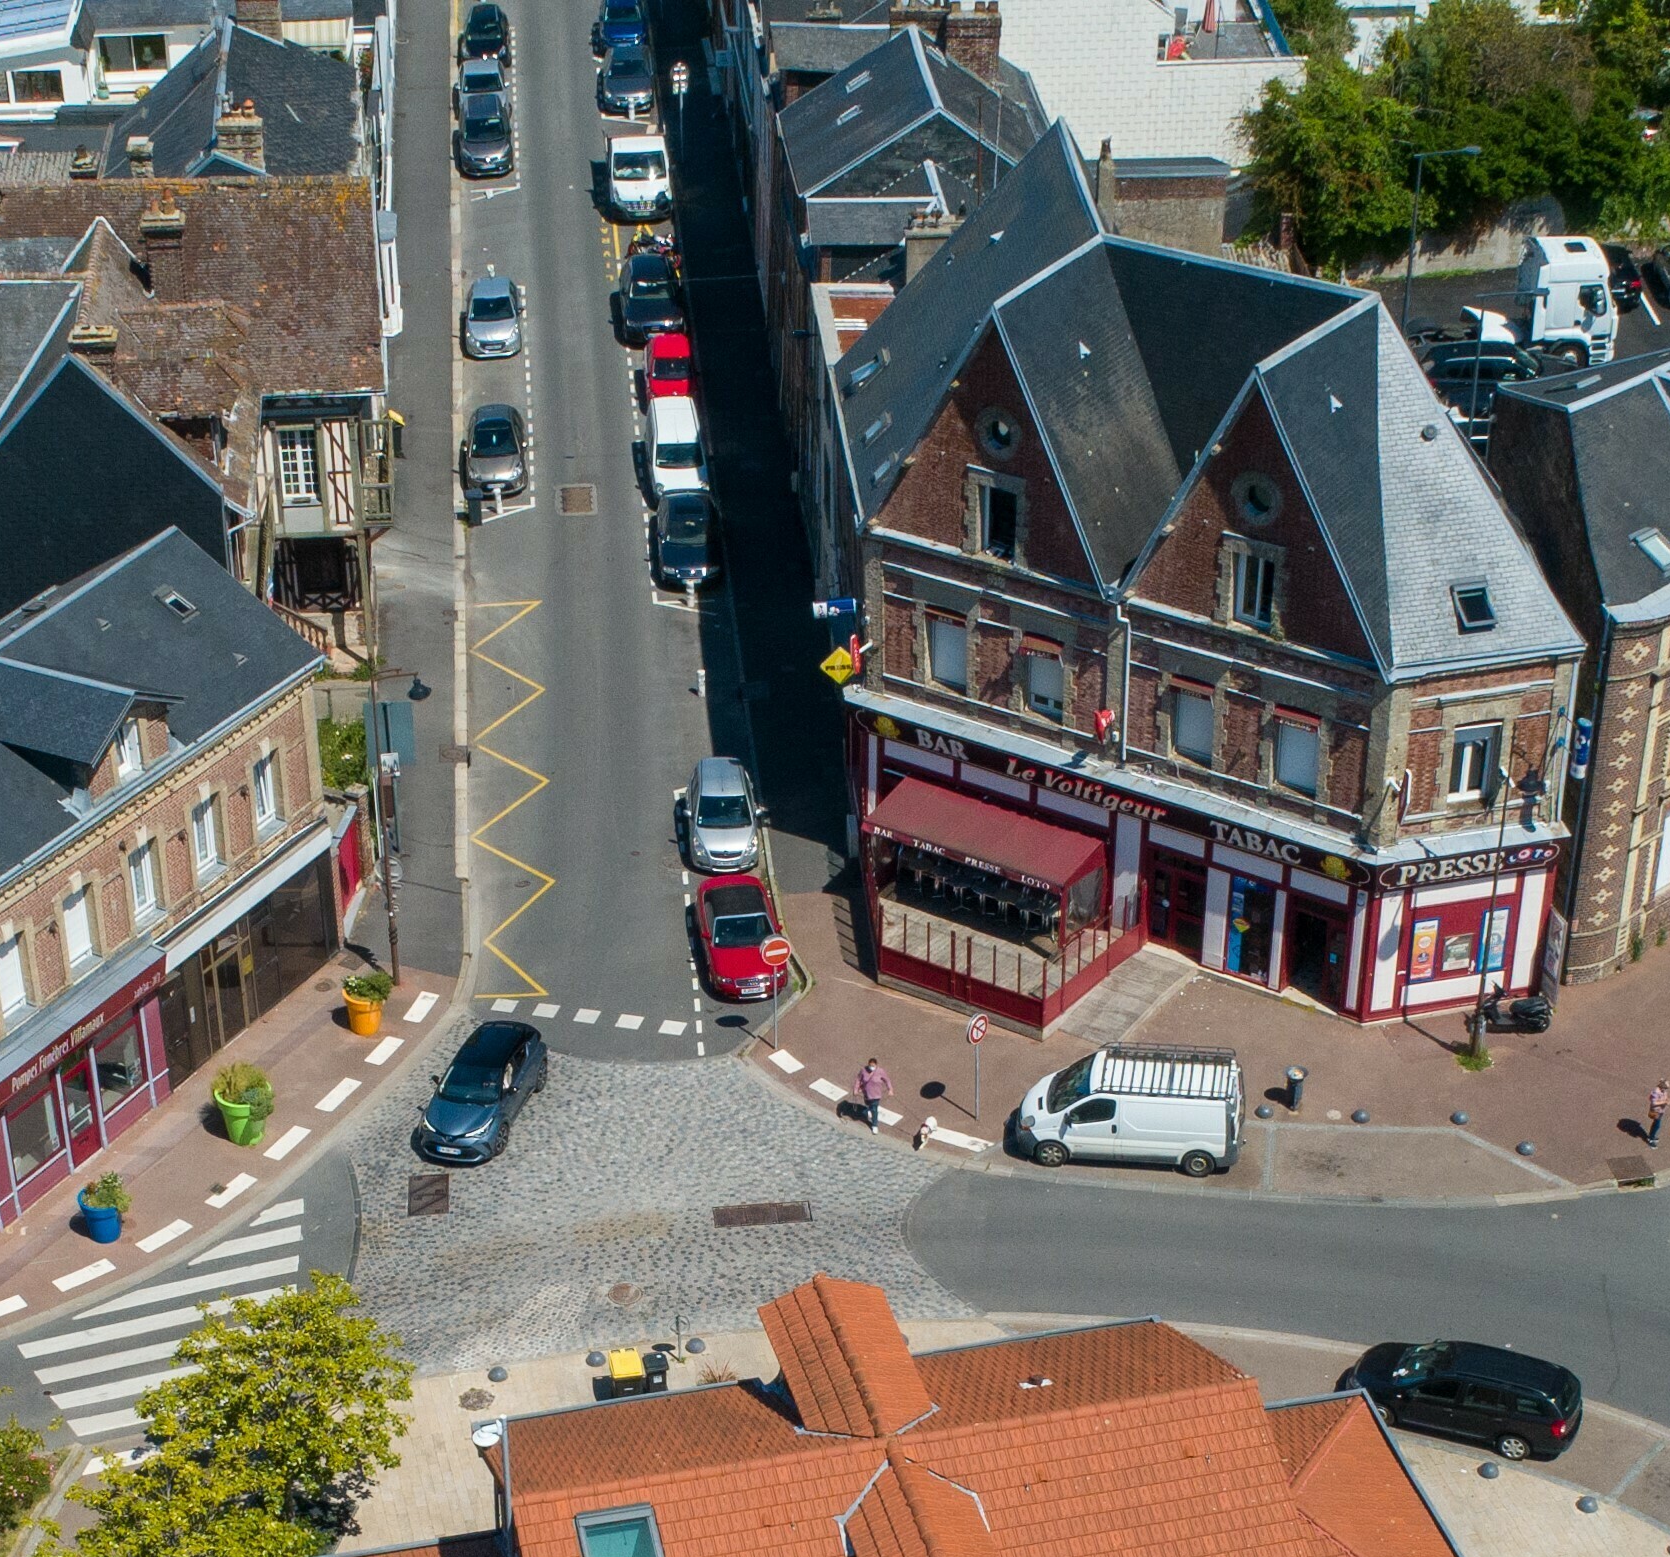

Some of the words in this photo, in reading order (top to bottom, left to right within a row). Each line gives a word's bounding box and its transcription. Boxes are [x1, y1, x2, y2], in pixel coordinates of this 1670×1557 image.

[915, 729, 969, 761] BAR
[1005, 757, 1036, 782] Le
[1044, 769, 1168, 820] Voltigeur
[873, 825, 894, 840] BAR
[912, 838, 946, 857] TABAC
[964, 856, 1001, 875] PRESSE
[1020, 874, 1050, 891] LOTO
[1210, 820, 1301, 864] TABAC
[1396, 851, 1505, 887] PRESSE
[1506, 848, 1553, 865] LOTO
[11, 1062, 38, 1093] Pompes
